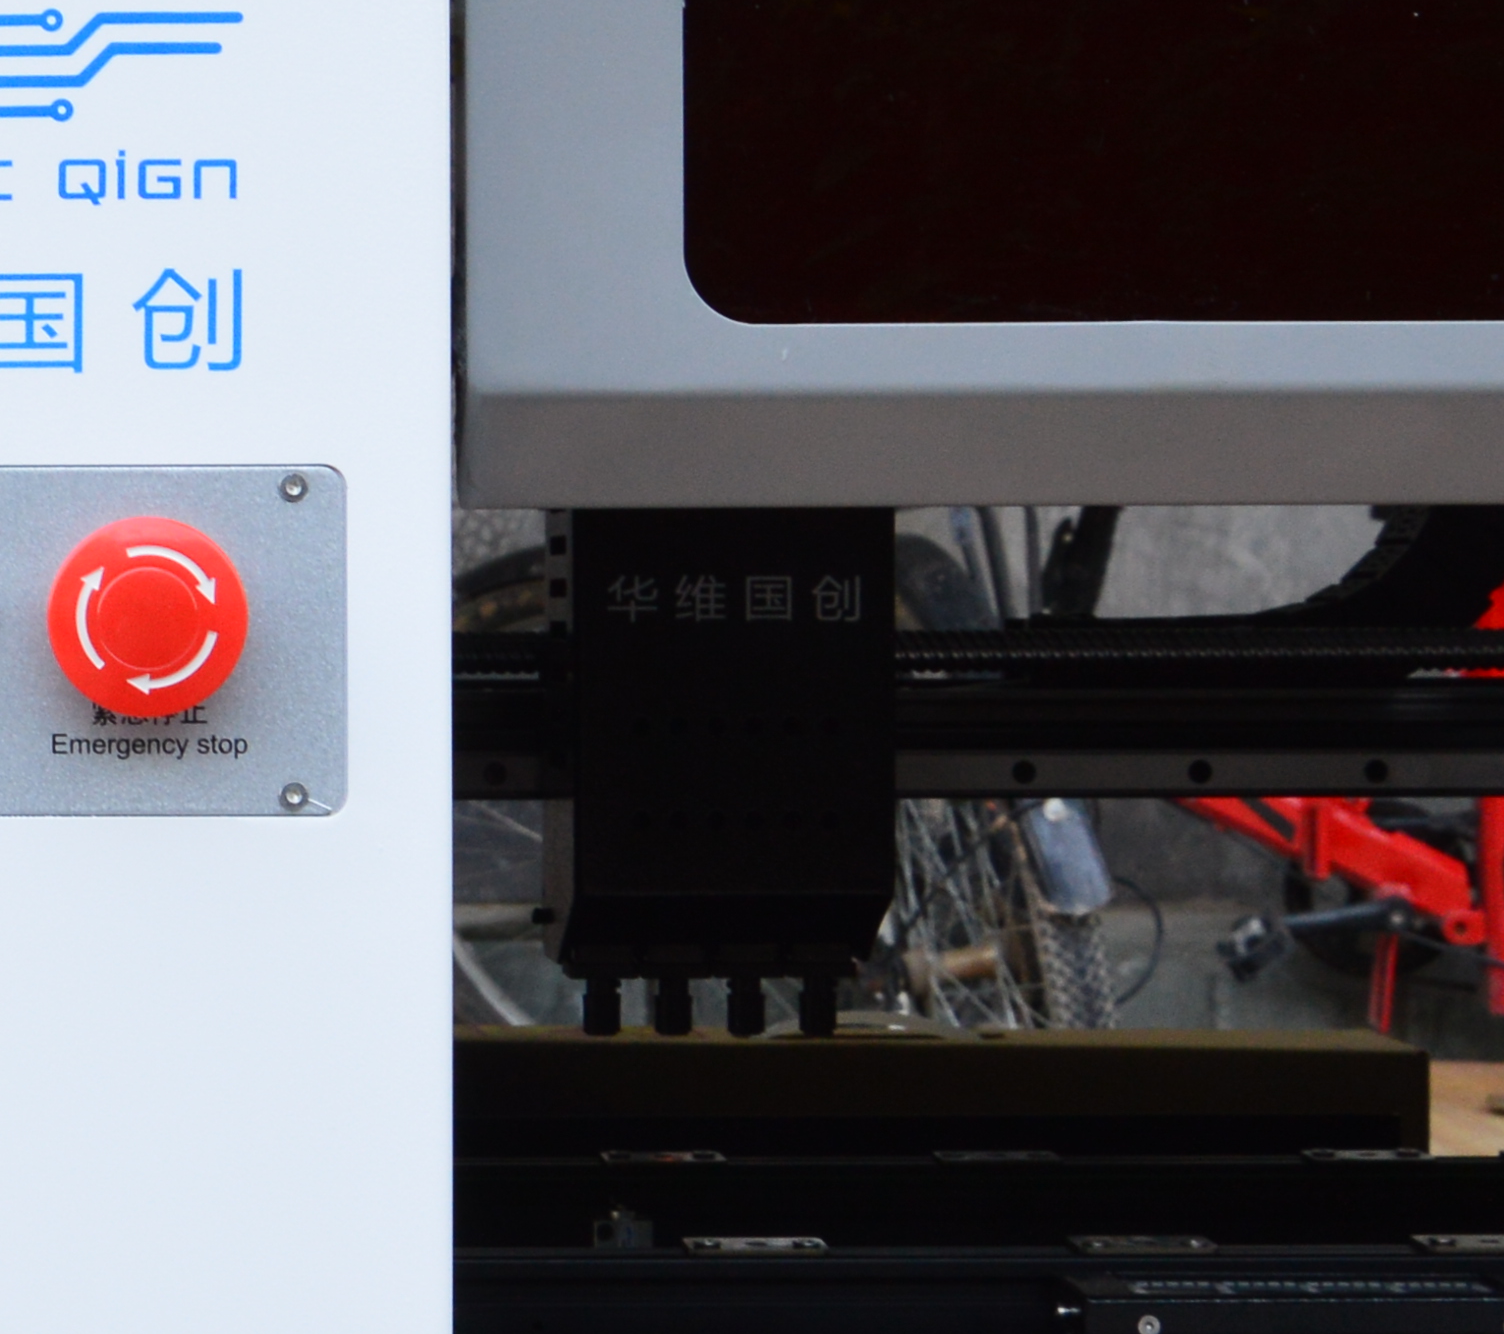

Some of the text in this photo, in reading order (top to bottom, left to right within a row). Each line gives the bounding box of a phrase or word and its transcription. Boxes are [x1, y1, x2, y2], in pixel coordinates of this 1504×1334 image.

[607, 574, 862, 623] 华维国创
[50, 732, 249, 761] Emergency stop
